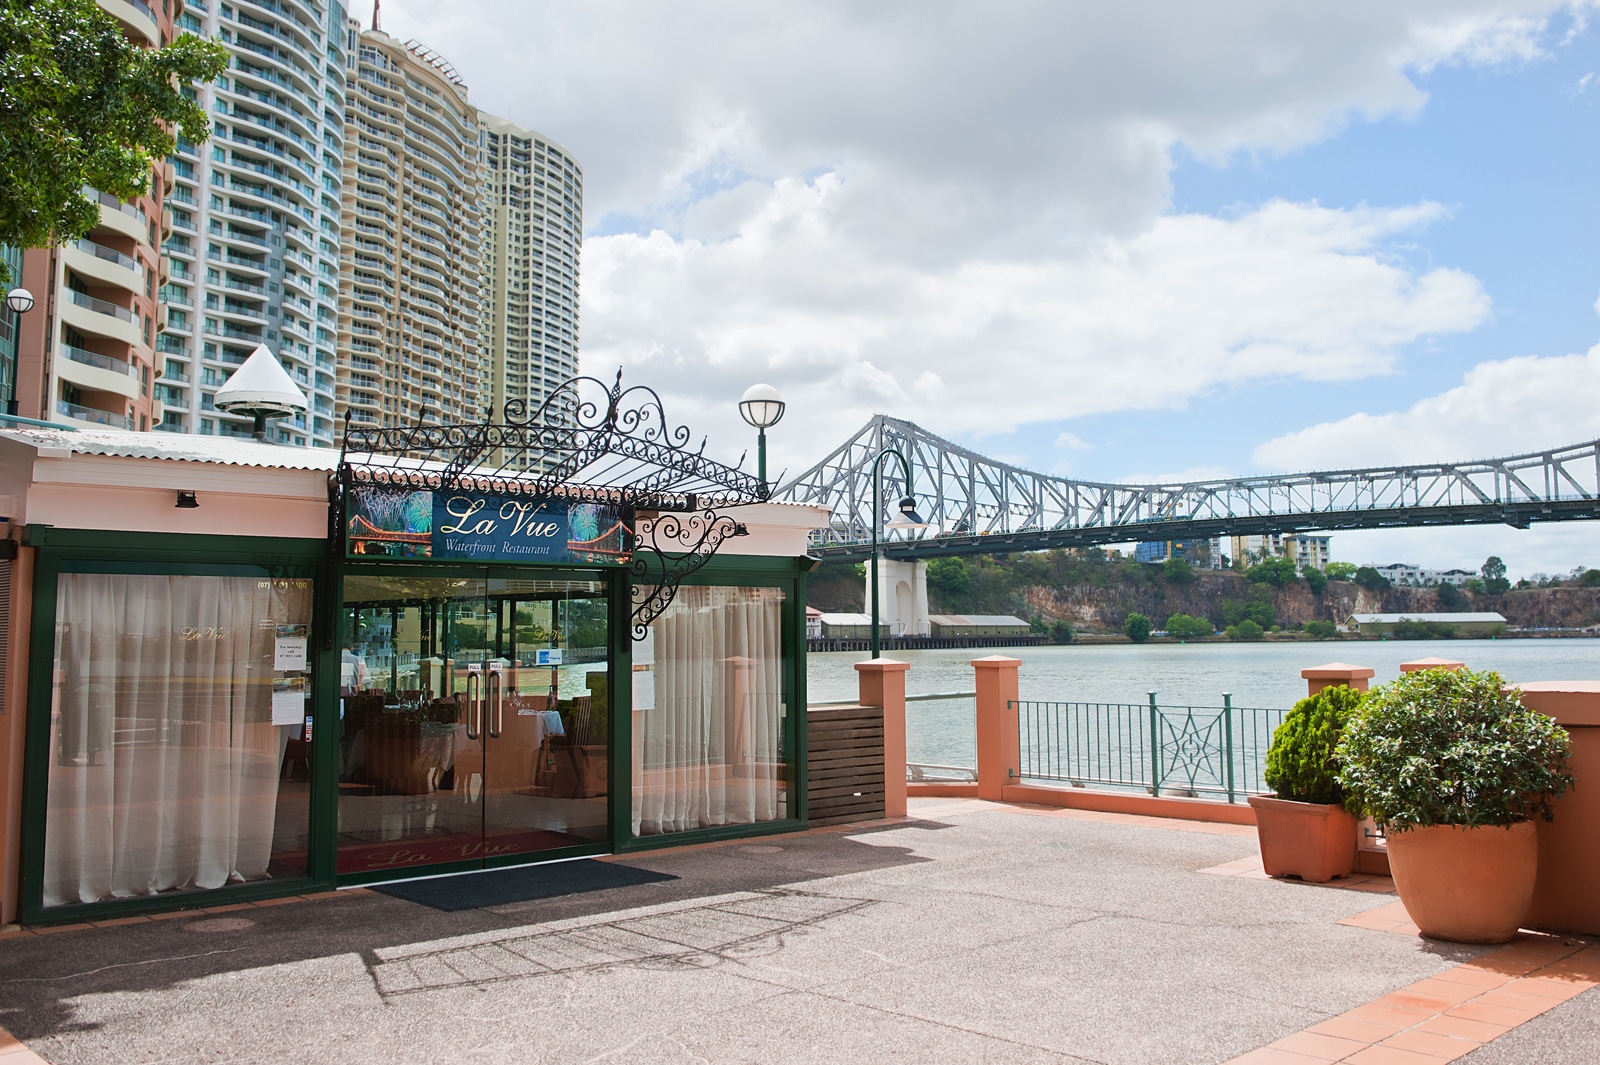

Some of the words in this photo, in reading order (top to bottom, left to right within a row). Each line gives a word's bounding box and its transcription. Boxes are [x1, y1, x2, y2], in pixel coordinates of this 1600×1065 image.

[440, 496, 498, 535] La
[499, 500, 560, 537] Vue
[446, 538, 497, 556] Waterfront
[502, 541, 550, 555] Restaurant
[257, 581, 270, 589] (07)
[179, 626, 201, 641] La
[367, 850, 432, 867] La
[440, 841, 521, 857] Vue
